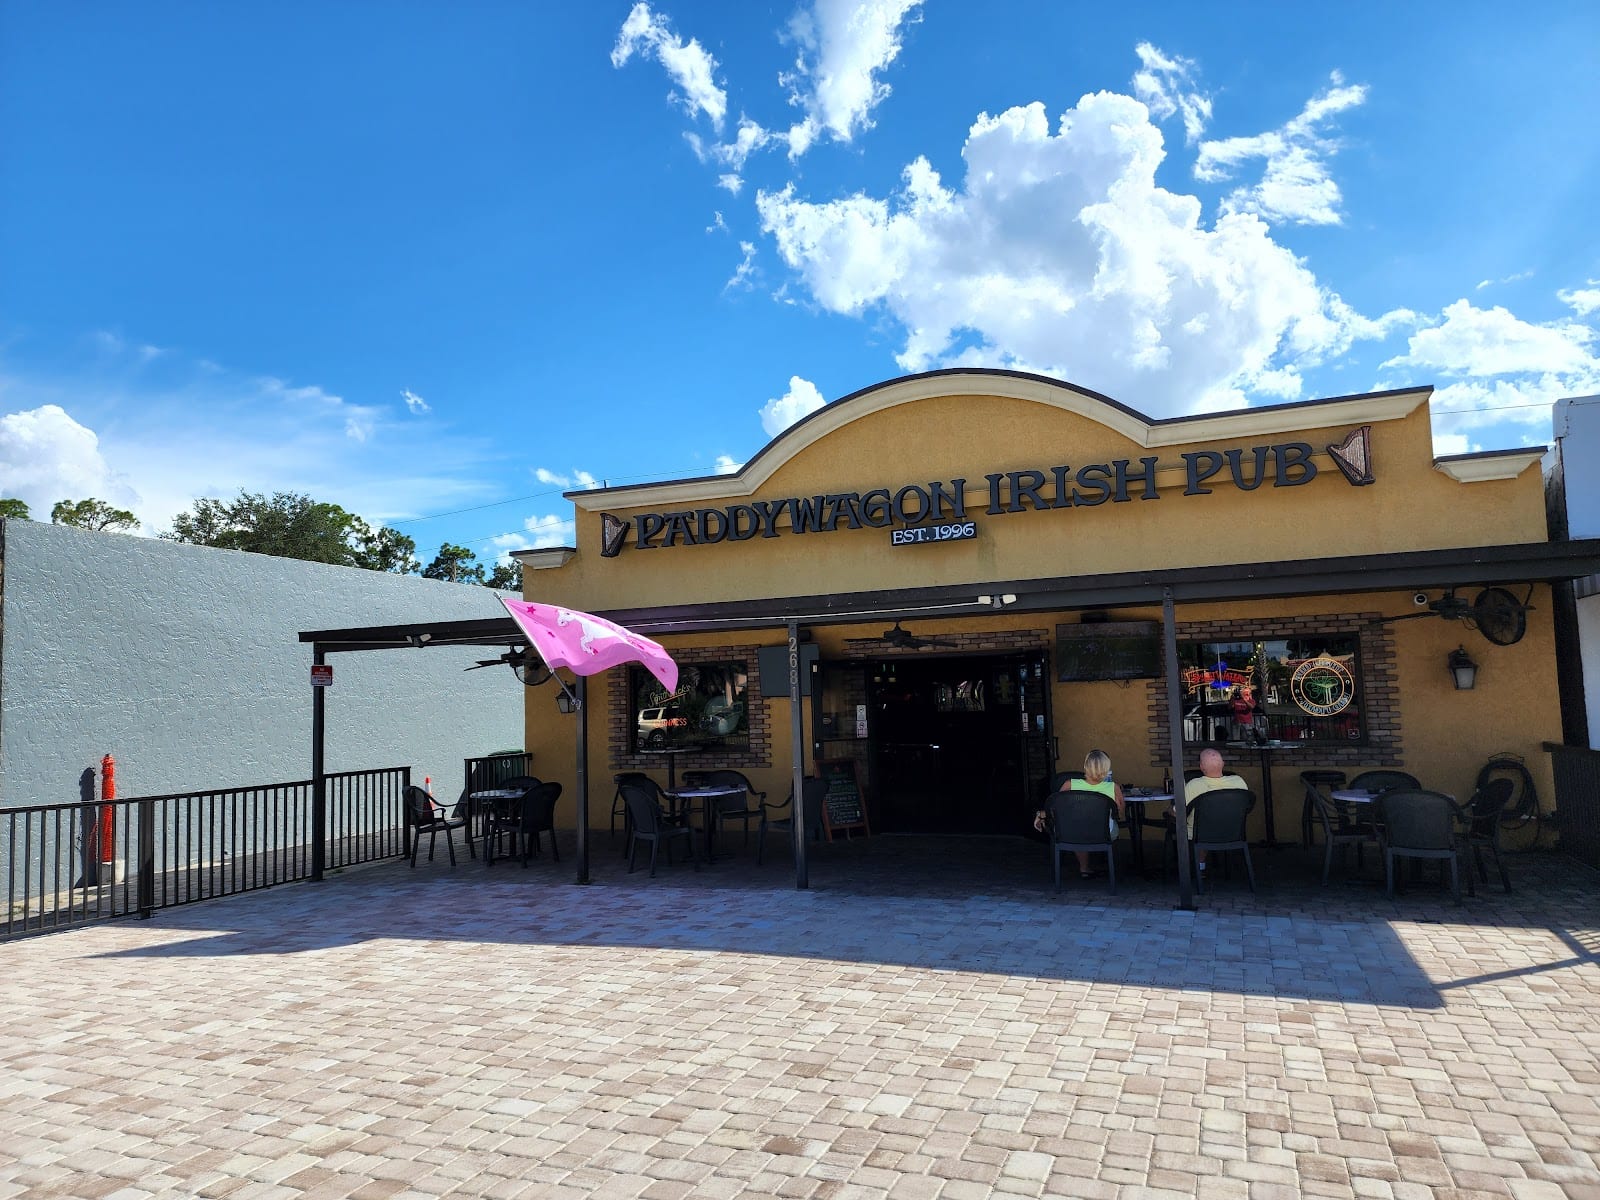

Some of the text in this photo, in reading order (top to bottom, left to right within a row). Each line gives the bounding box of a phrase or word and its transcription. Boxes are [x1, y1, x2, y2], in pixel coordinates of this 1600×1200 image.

[635, 442, 1318, 550] PADDYWAGON IRISH PUB
[892, 522, 975, 545] EST. 1996
[788, 637, 799, 702] 2681
